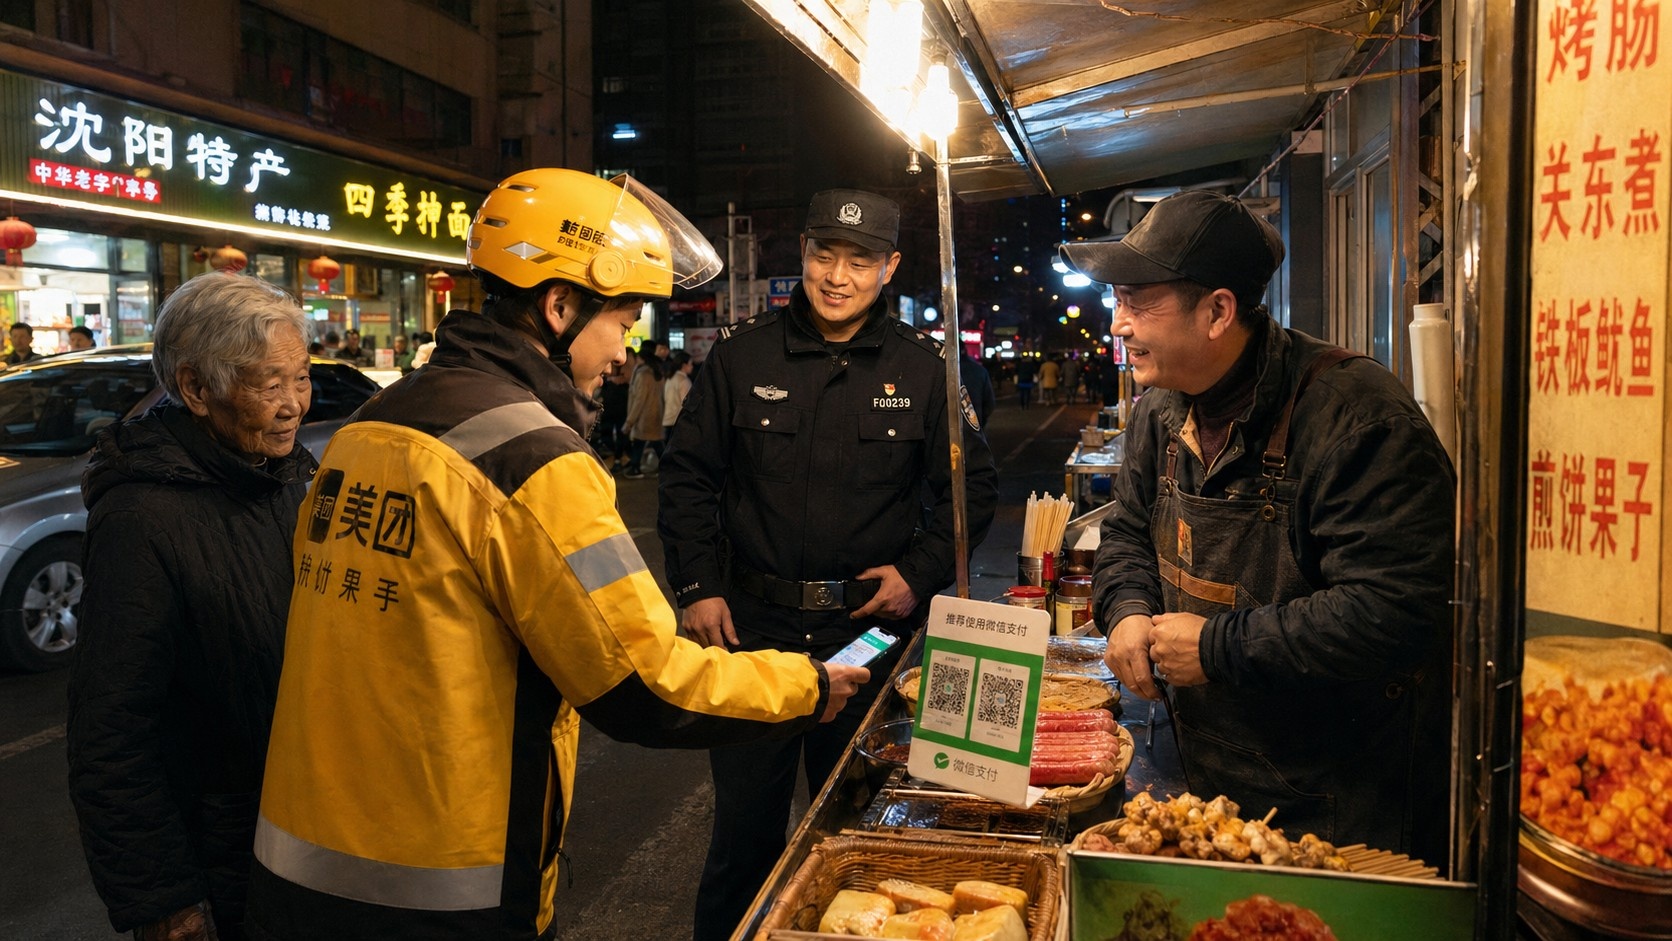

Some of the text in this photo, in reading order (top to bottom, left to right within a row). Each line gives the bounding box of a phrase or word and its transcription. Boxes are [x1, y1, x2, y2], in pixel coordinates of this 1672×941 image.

[1546, 0, 1660, 83] 烤肠
[34, 97, 291, 193] 沈阳特产
[1540, 128, 1662, 242] 关东煮
[344, 181, 471, 240] 四季抻面
[1535, 297, 1655, 397] 铁板鱿鱼
[873, 397, 911, 408] F00239
[335, 482, 416, 559] 美团
[1529, 449, 1653, 562] 煎饼果子
[945, 612, 1028, 637] 推荐使用微信支付
[953, 757, 998, 782] 微信支付
